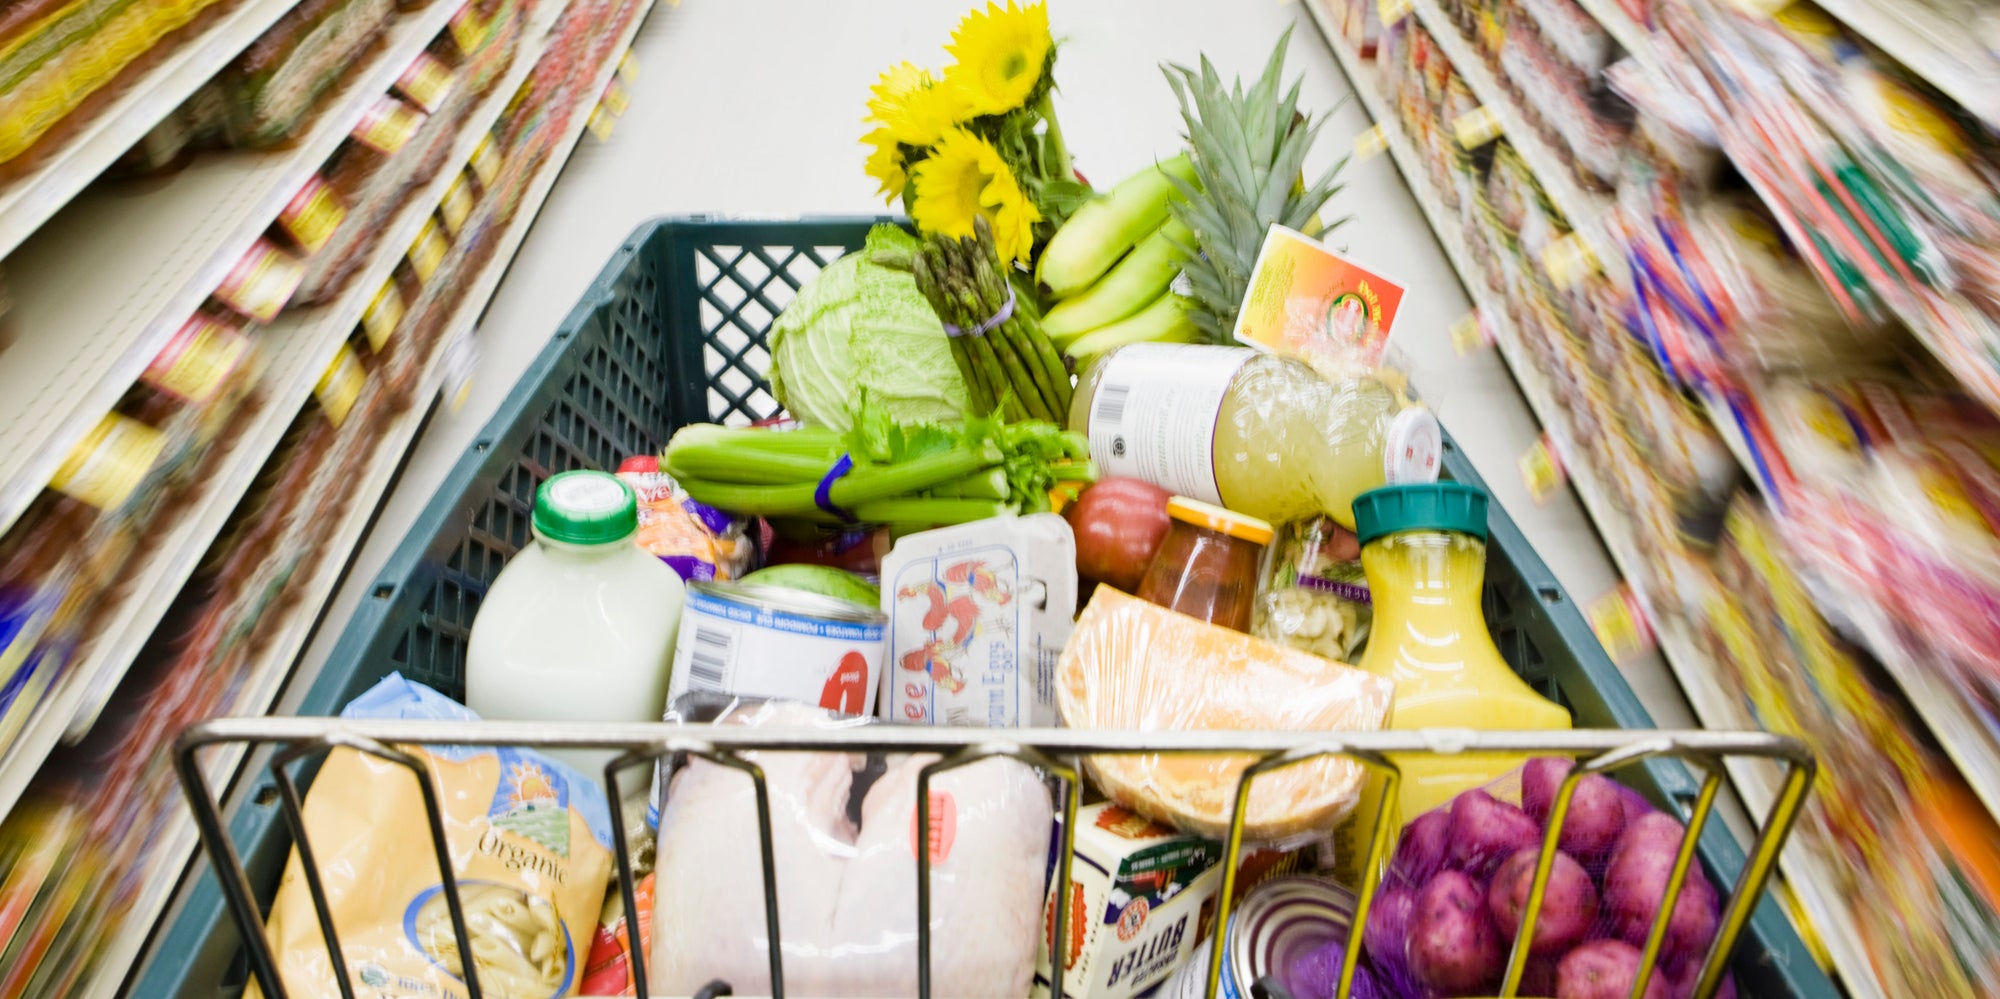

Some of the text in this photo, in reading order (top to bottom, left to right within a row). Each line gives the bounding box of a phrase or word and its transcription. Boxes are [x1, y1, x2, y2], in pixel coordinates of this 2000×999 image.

[1315, 579, 1371, 602] AGHETTI
[905, 682, 927, 720] ee
[476, 829, 568, 887] Organic
[1106, 912, 1188, 988] BUTTER
